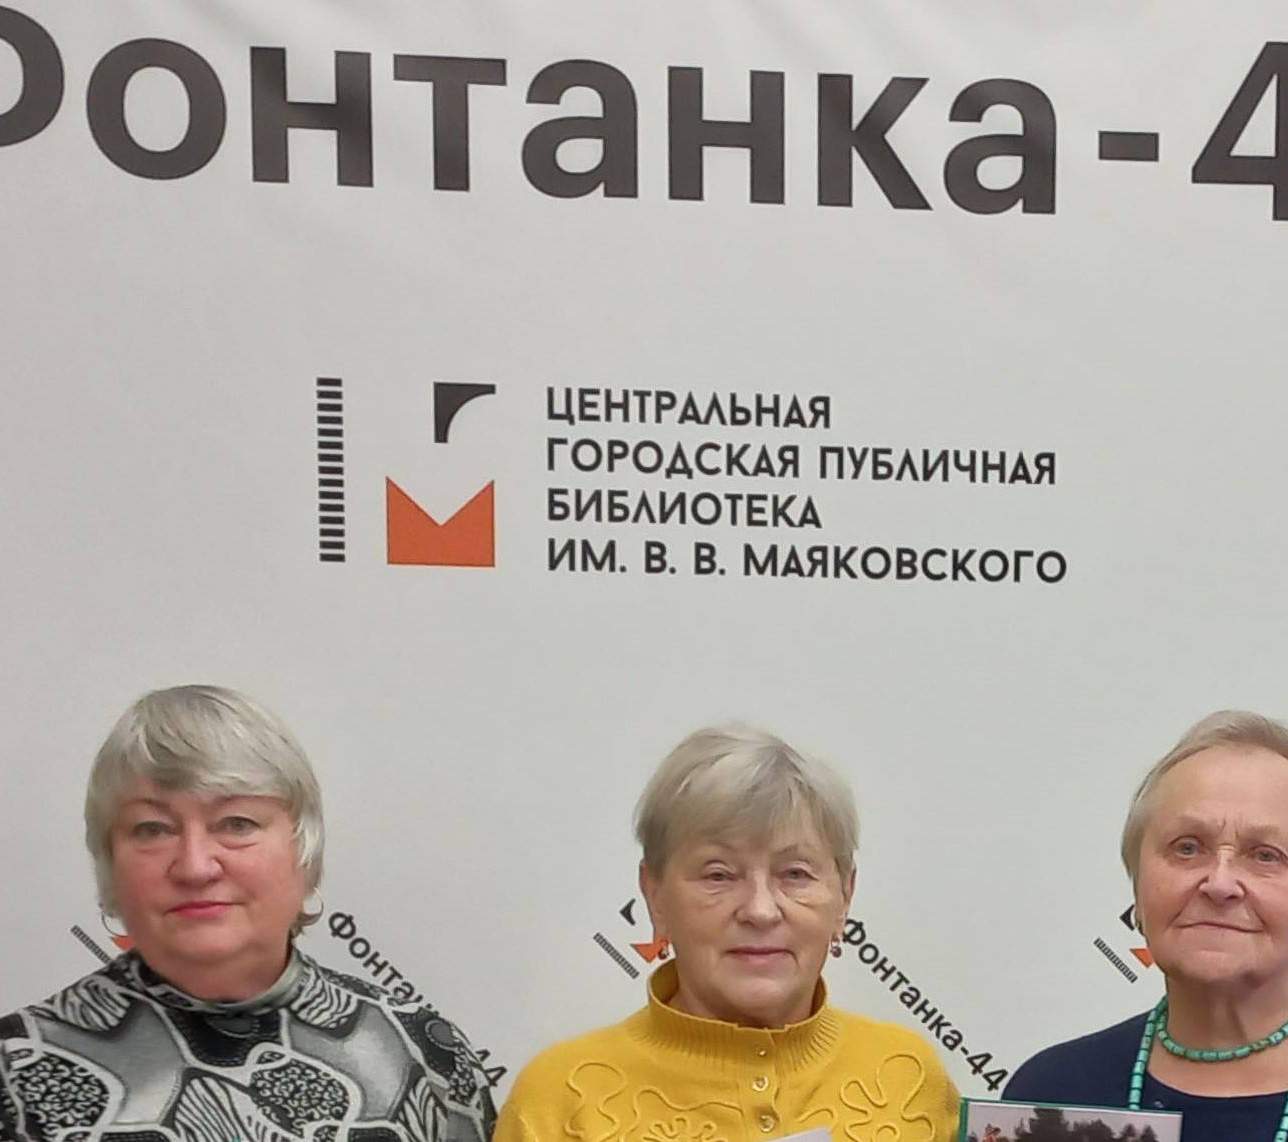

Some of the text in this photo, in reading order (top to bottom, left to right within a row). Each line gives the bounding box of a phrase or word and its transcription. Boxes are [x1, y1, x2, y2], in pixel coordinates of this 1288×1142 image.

[547, 387, 831, 429] ЦЕНТРАЛЬНАЯ
[547, 438, 1056, 485] ГОРОДСКАЯ ПУБЛИЧНАЯ
[548, 488, 822, 529] БИБЛИОТЕКА
[548, 538, 1067, 583] ИМ. В. В. МАЯКОВСКОГО
[842, 918, 1010, 1092] Фонтанка-44
